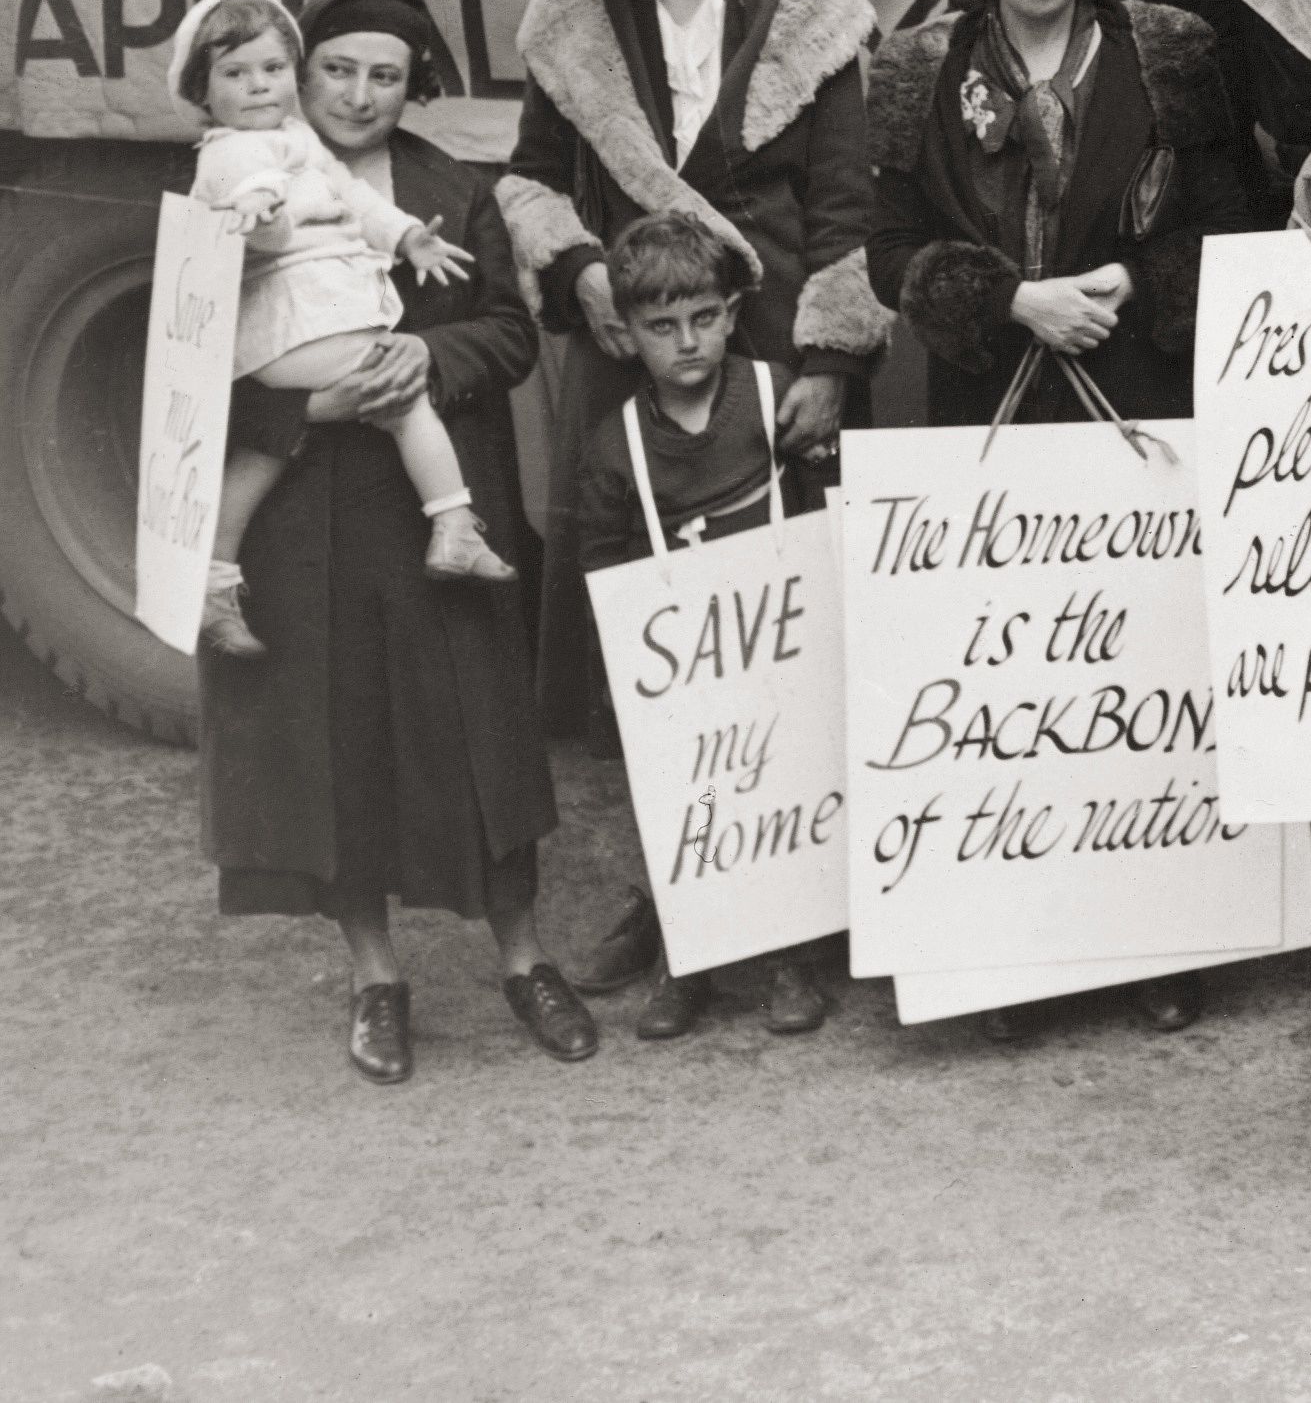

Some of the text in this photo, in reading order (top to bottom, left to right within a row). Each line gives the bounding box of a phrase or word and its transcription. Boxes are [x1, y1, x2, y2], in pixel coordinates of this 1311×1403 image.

[870, 493, 949, 576] The
[635, 575, 805, 698] SAVE
[962, 589, 1129, 668] is the
[1226, 639, 1289, 699] are
[692, 712, 781, 793] my
[866, 677, 1216, 771] BACKBON
[669, 790, 844, 886] Home
[874, 778, 1249, 894] of the nation
